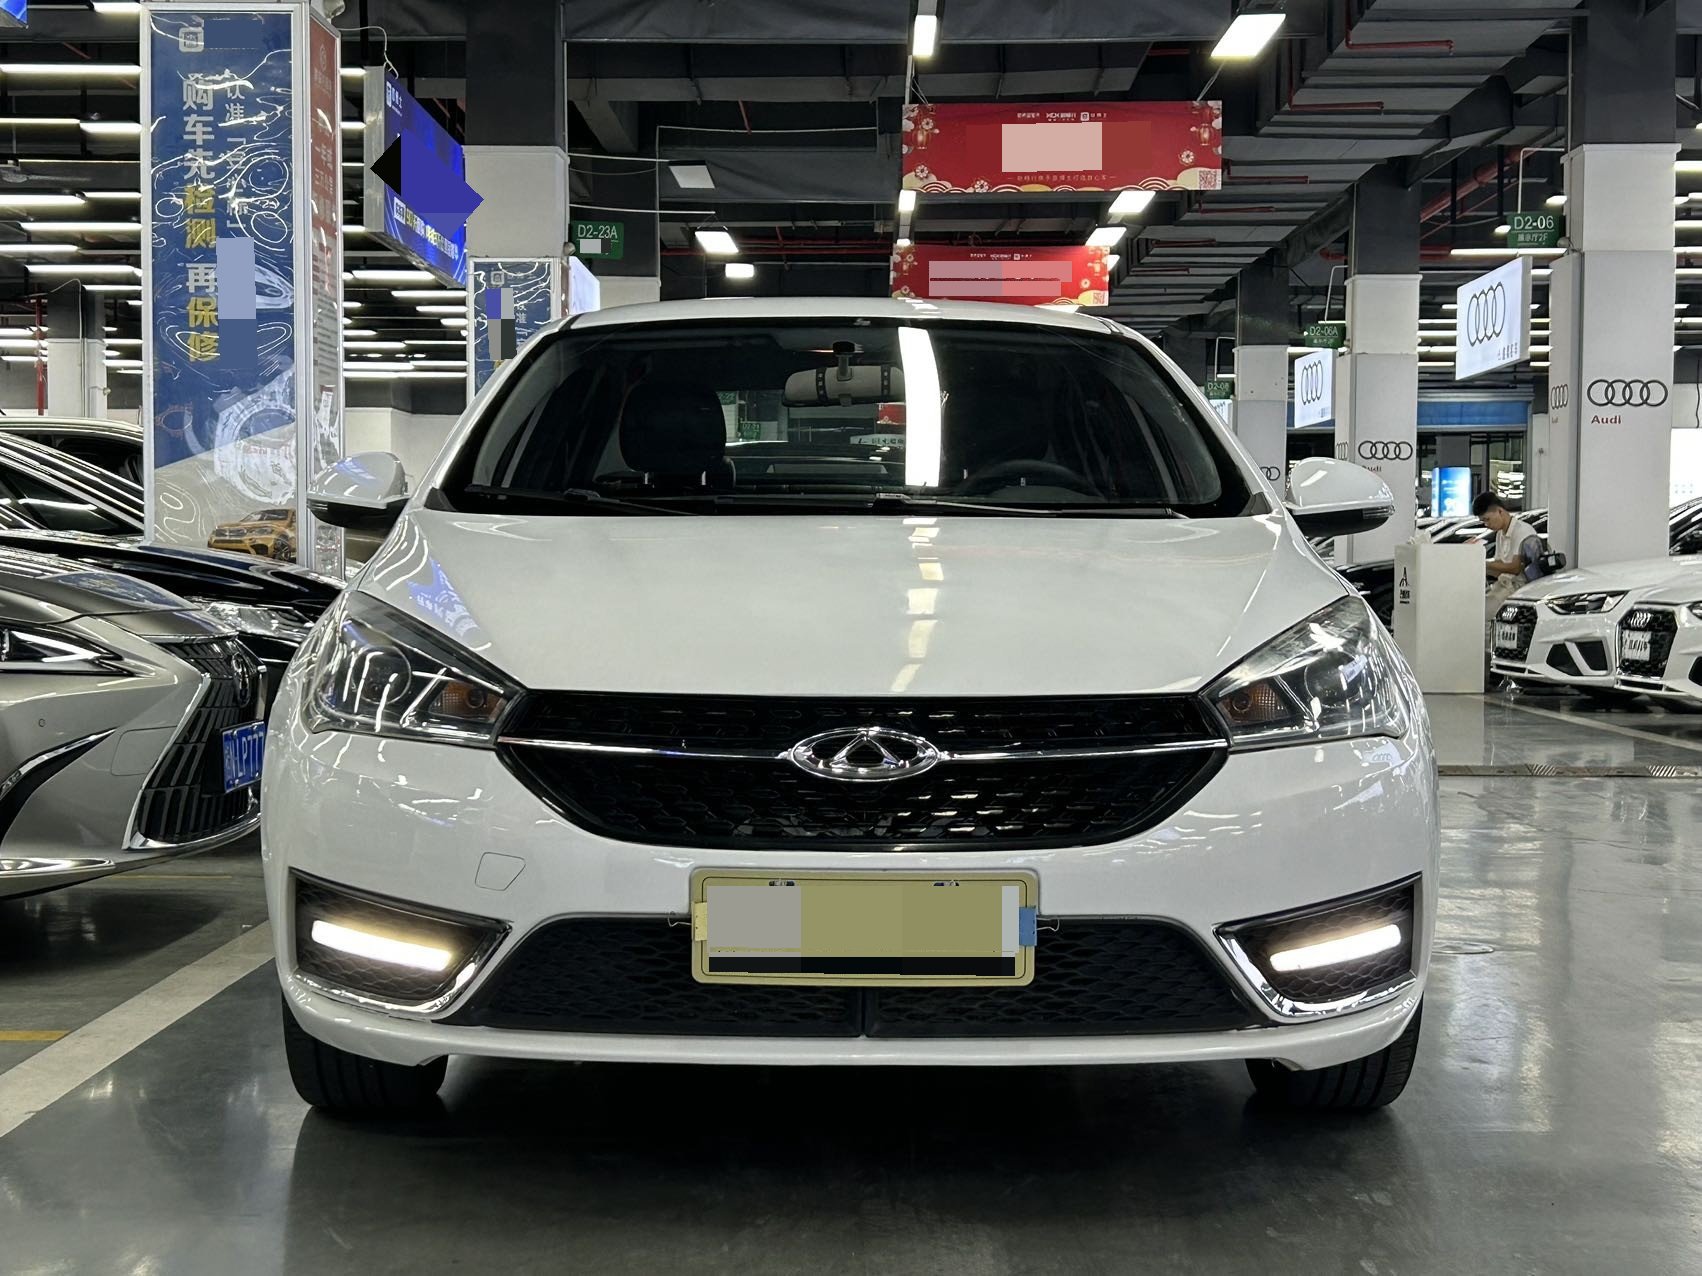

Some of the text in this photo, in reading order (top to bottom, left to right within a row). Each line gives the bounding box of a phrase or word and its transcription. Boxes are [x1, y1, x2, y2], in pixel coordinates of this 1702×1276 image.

[1514, 215, 1554, 230] D2-06
[577, 224, 618, 239] D2-23A
[186, 262, 219, 363] 再保修
[1309, 326, 1339, 337] D2-06A
[1591, 415, 1622, 425] Audi
